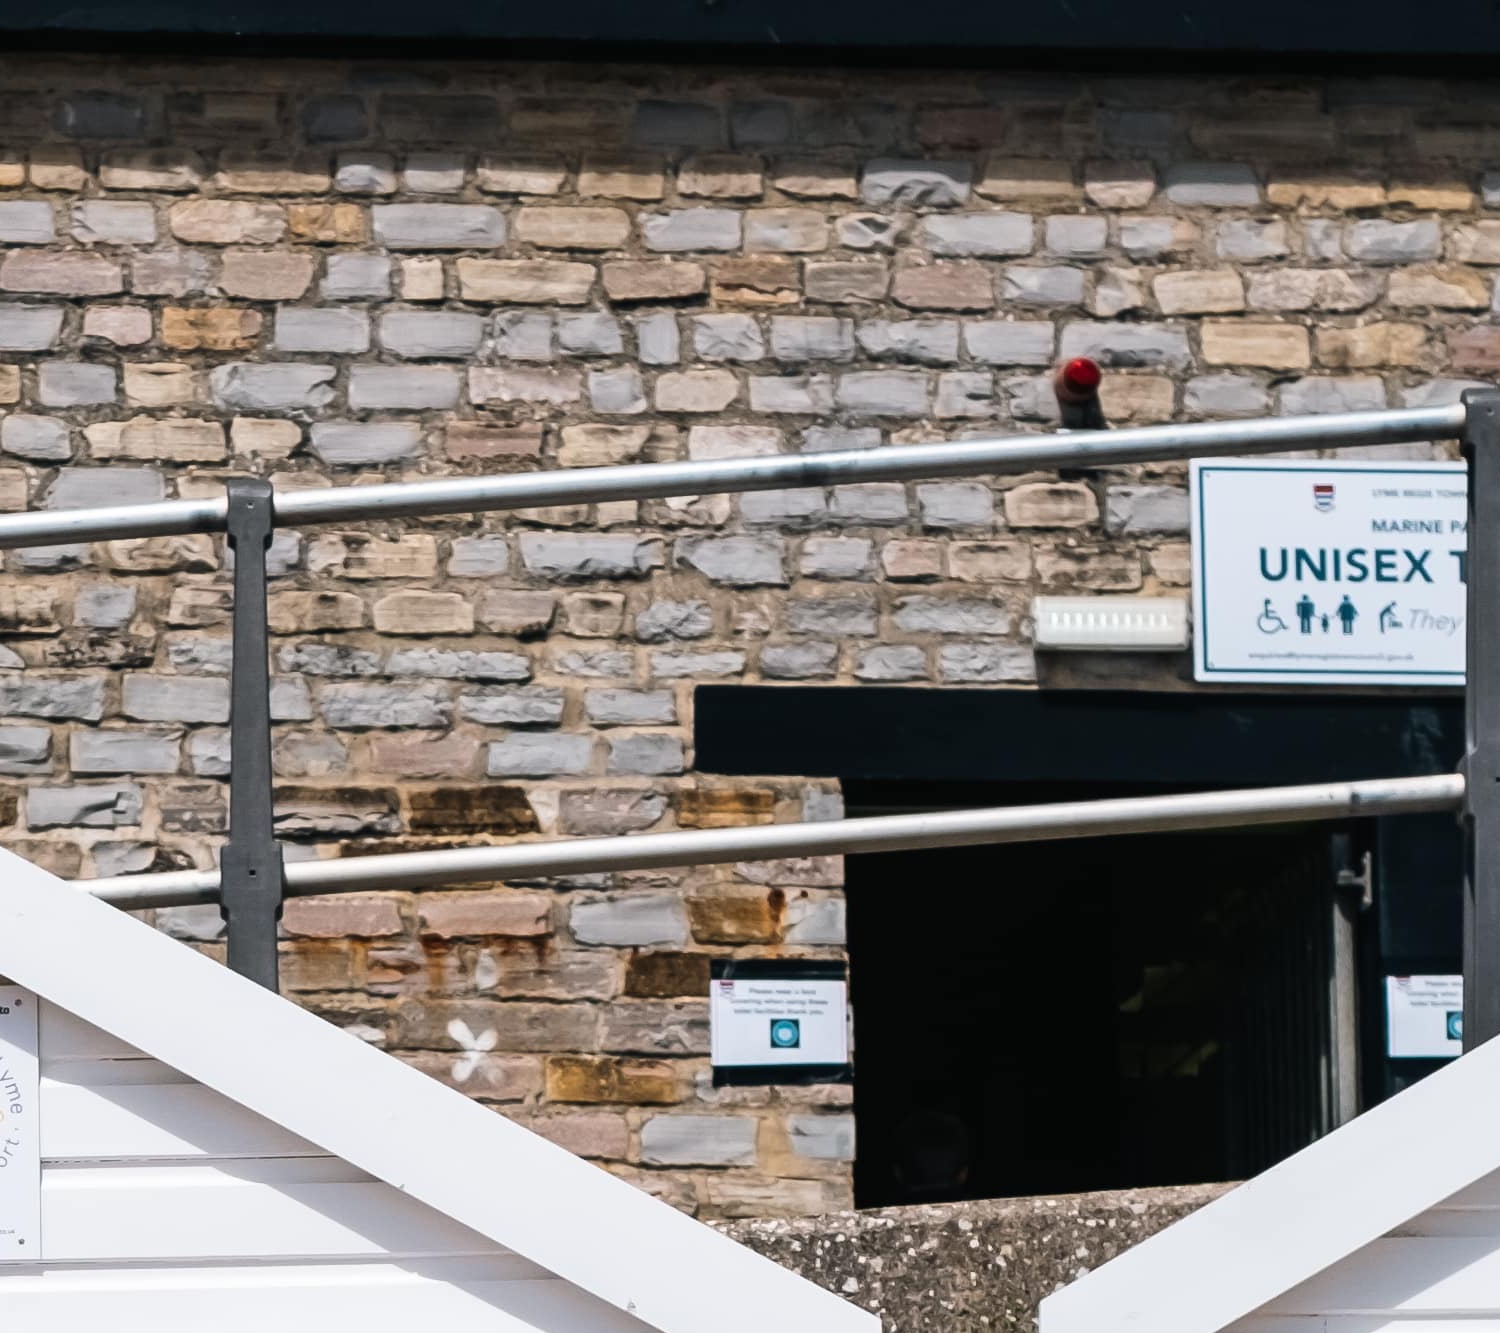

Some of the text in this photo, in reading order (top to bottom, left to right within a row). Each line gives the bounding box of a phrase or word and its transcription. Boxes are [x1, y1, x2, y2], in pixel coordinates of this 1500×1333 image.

[1372, 519, 1443, 534] MARINE
[1259, 547, 1434, 584] UNISEX
[1409, 608, 1464, 636] They
